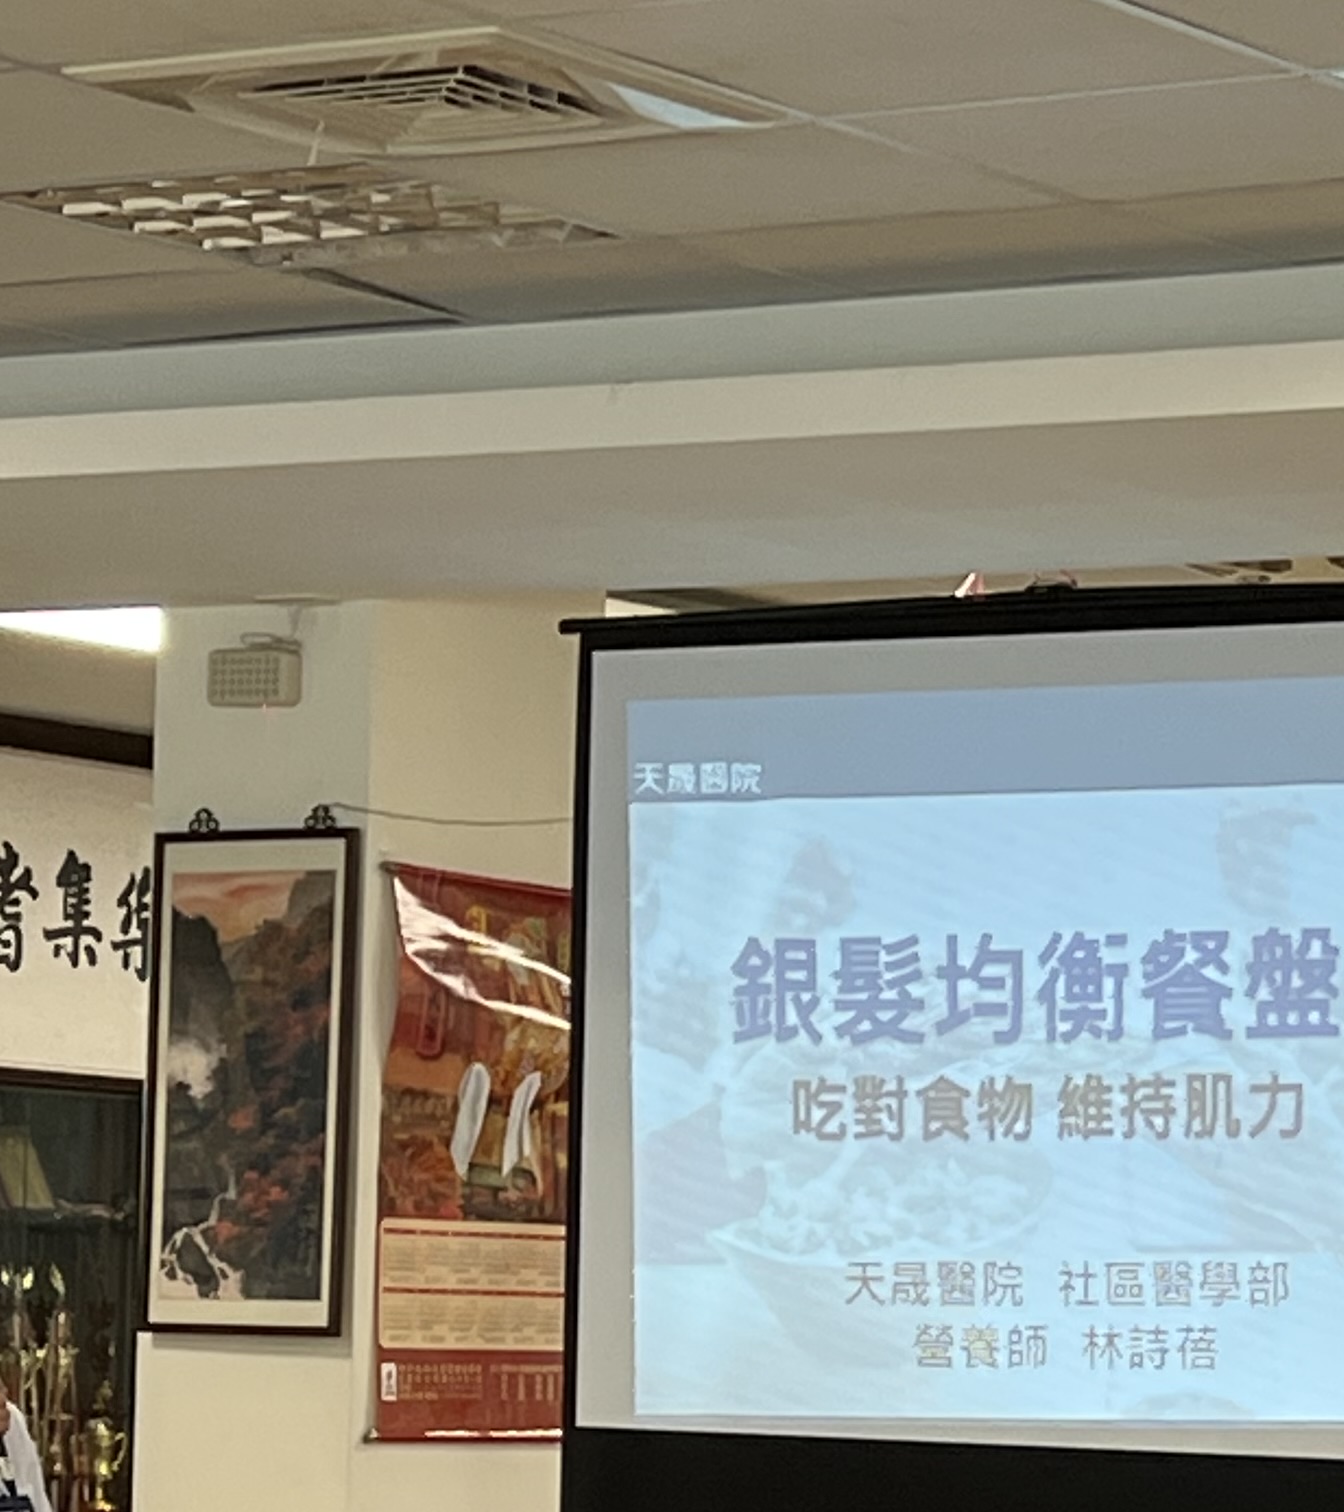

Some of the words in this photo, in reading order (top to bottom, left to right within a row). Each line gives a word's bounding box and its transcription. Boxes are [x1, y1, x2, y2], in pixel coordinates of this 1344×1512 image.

[633, 761, 763, 796] 天晟醫院
[730, 926, 1341, 1047] 銀髮均衡餐盤
[792, 1074, 1034, 1142] 吃對食物
[1056, 1071, 1305, 1142] 維持肌力
[844, 1260, 1024, 1308] 天晟醫院
[1057, 1259, 1292, 1309] 社區醫學部
[911, 1322, 1050, 1370] 營養師
[1081, 1322, 1221, 1371] 林詩蓓
